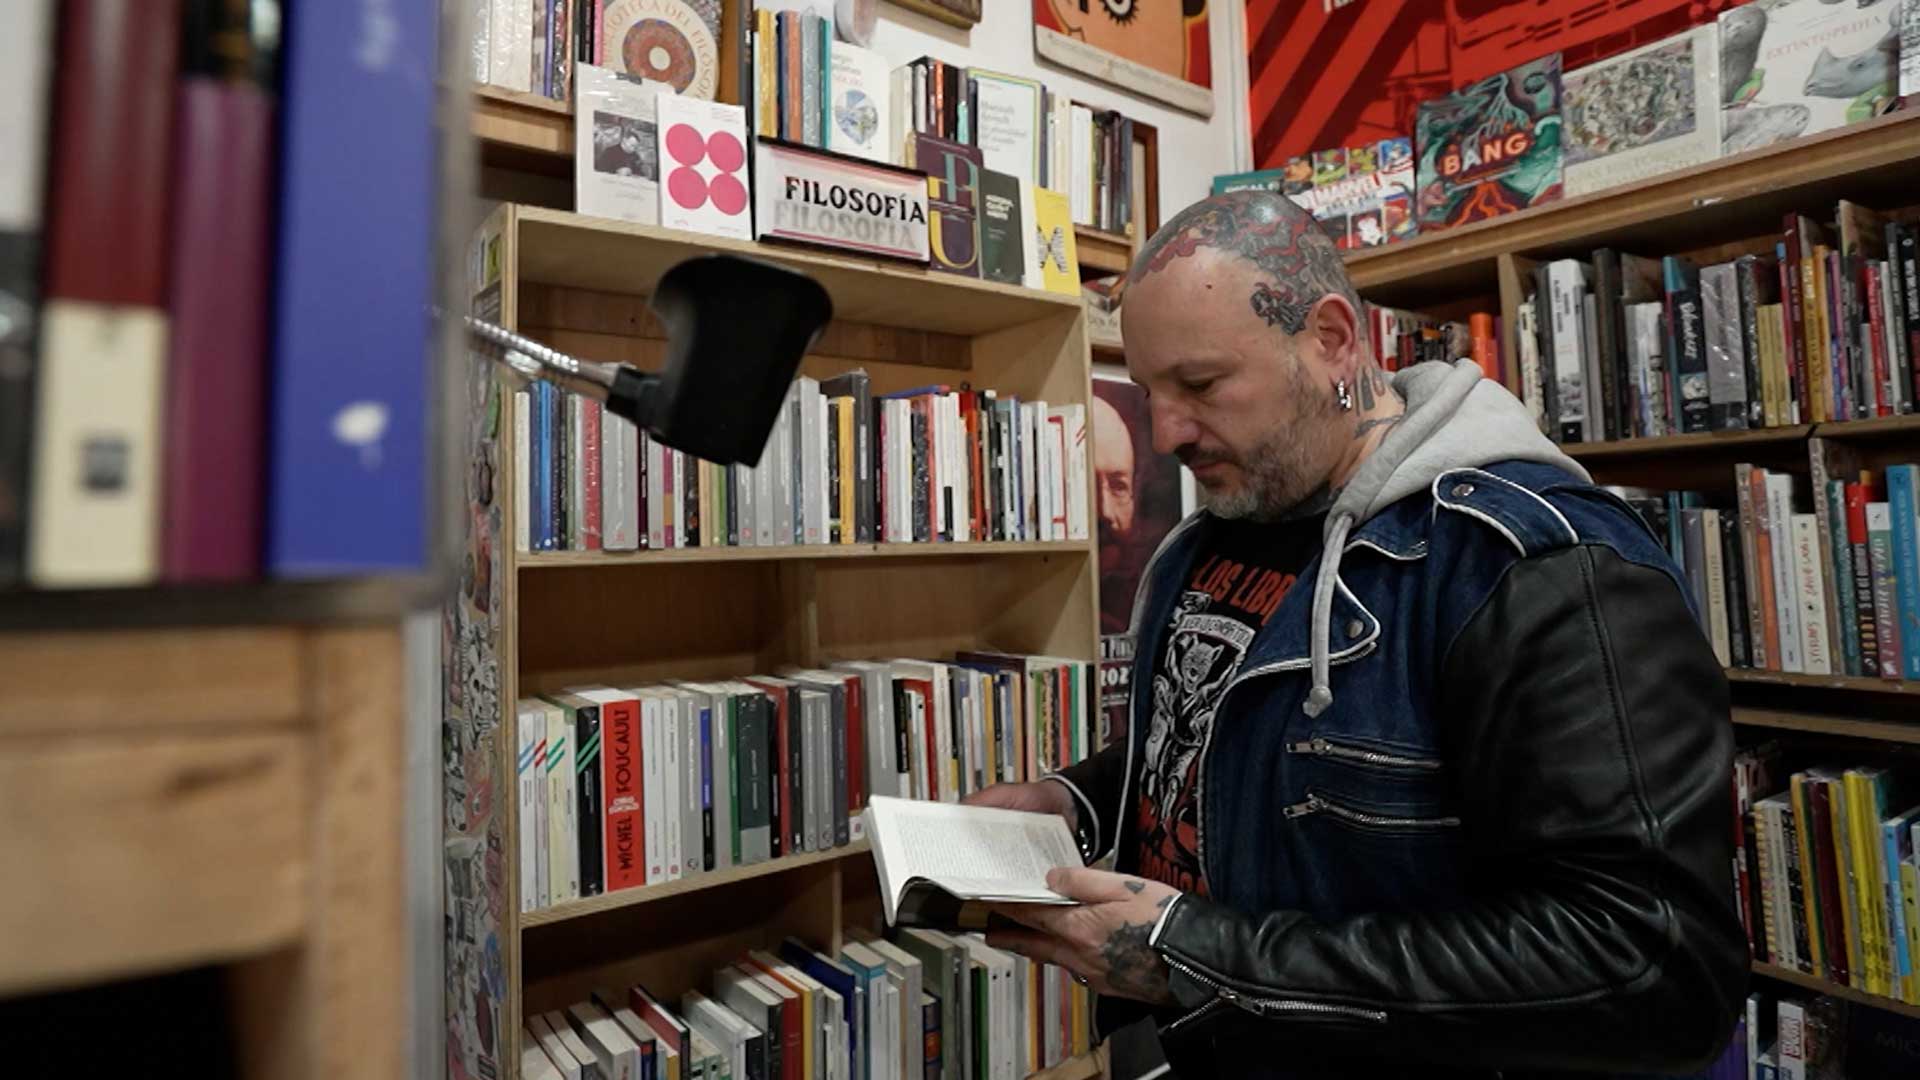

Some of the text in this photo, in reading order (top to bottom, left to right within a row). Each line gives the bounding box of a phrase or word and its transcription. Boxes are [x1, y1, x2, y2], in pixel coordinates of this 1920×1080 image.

[1442, 132, 1529, 177] BANG
[784, 175, 927, 225] FILOSOFÍA
[1191, 555, 1245, 603] LOS
[614, 708, 632, 793] FOUCAULT
[617, 814, 633, 871] MICHEL
